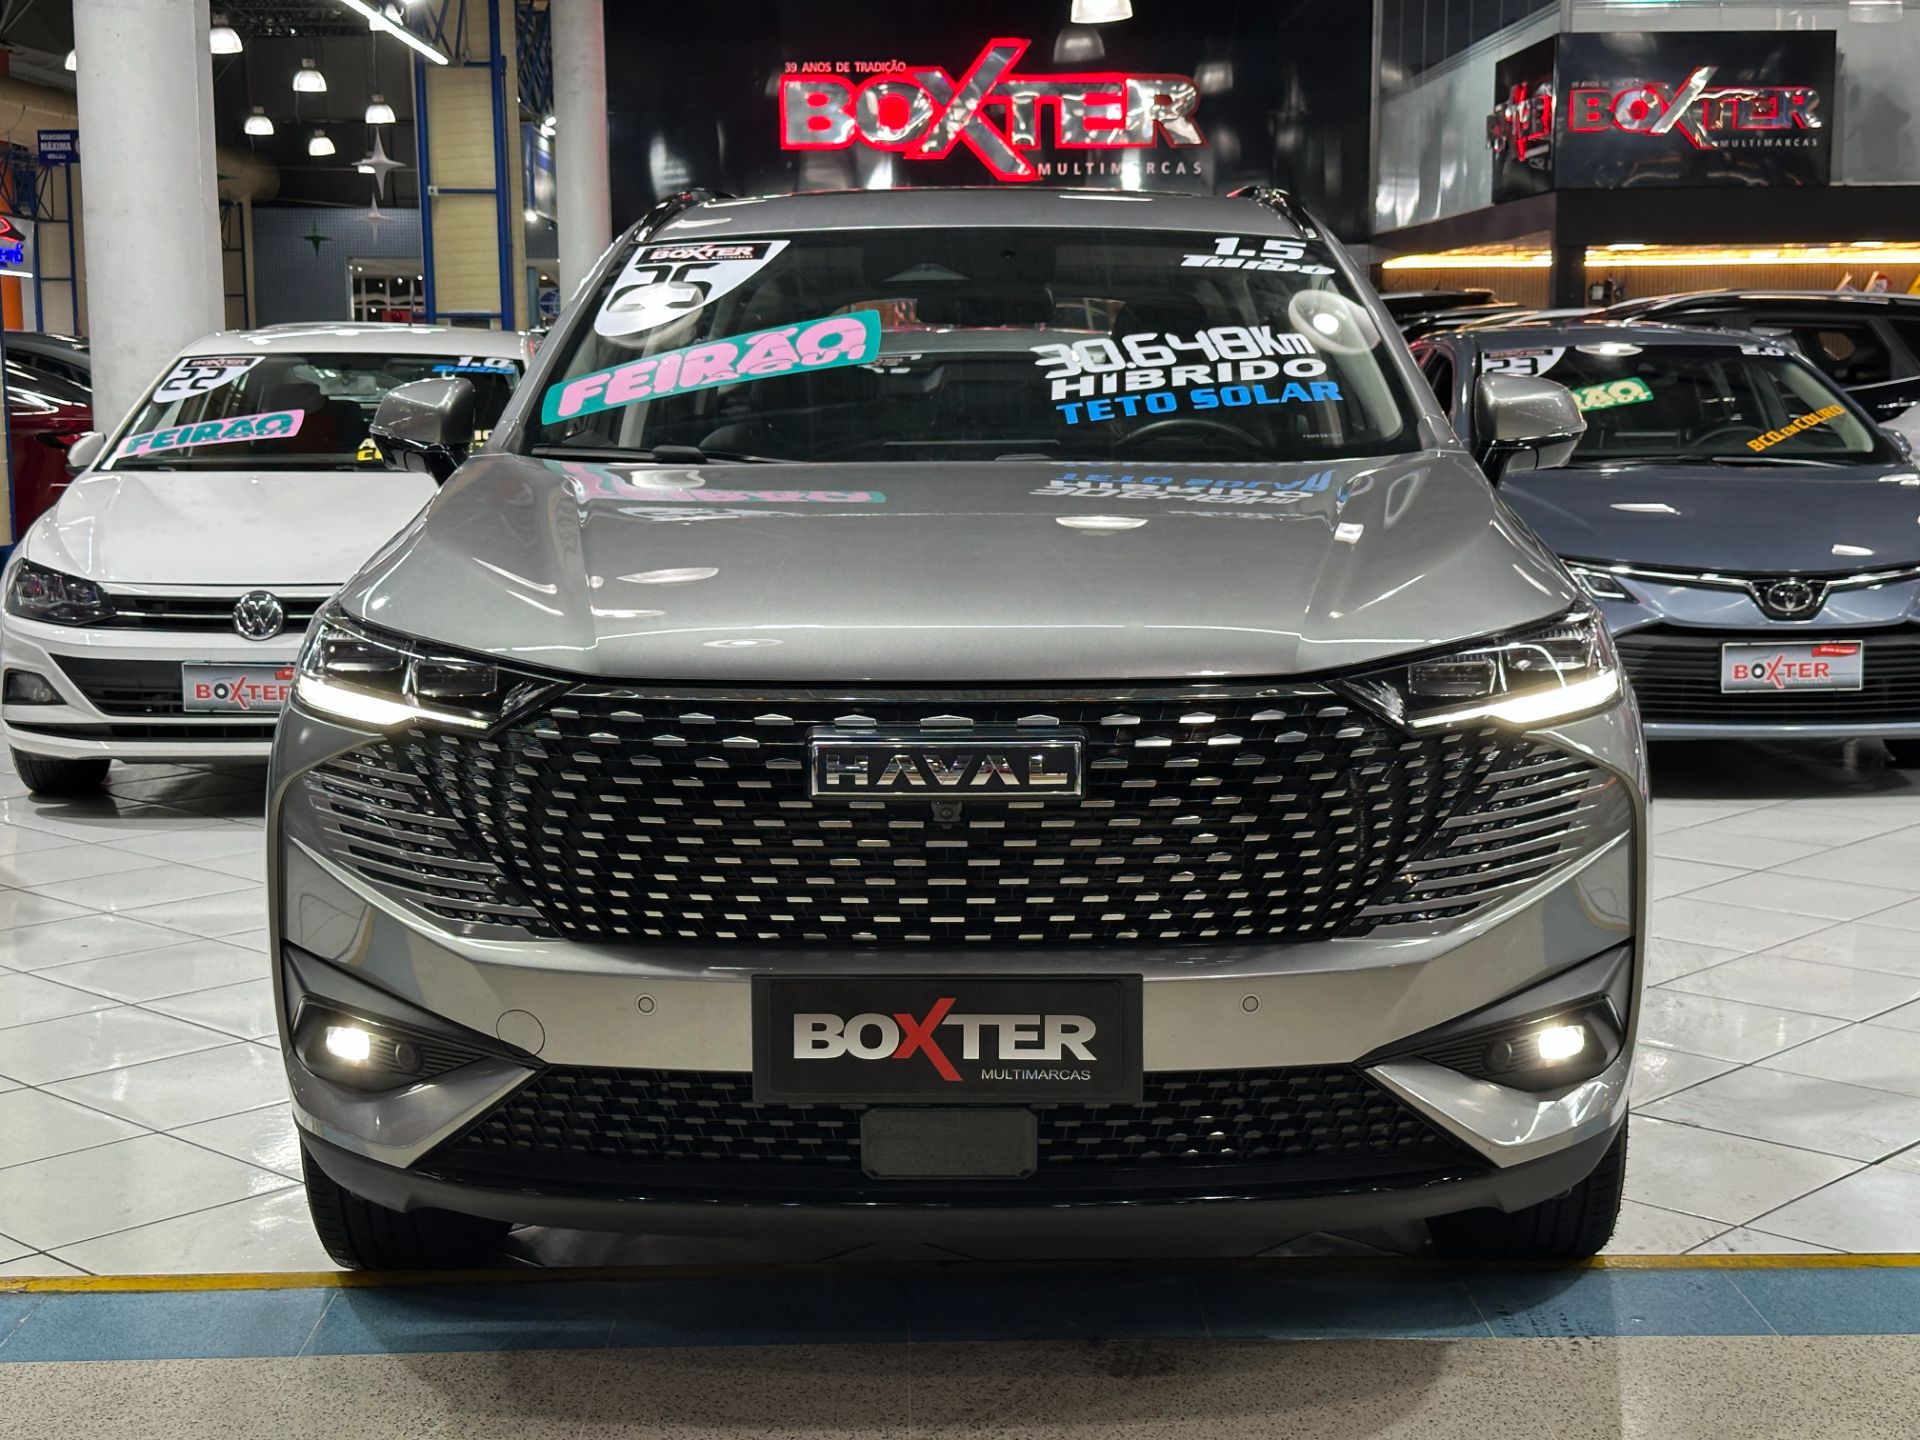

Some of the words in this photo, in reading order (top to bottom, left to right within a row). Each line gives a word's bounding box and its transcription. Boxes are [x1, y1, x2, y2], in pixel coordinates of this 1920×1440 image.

[784, 61, 798, 73] 39
[802, 61, 832, 73] ANOS
[836, 61, 850, 73] DE
[854, 60, 906, 74] TRADIÇÃO
[780, 38, 1209, 181] BOXTER
[1568, 65, 1822, 150] BOXTER
[1719, 137, 1819, 148] MULTIMARCAS
[1037, 162, 1202, 175] MULTIMRCAS
[649, 243, 754, 262] BOXTER
[1215, 237, 1307, 260] 1.5
[1181, 254, 1336, 275] Turbo
[458, 356, 509, 369] 1.0
[1030, 325, 1316, 379] 30.648Km
[161, 367, 227, 392] 22
[558, 318, 867, 417] FEIRÃO
[1056, 391, 1178, 425] TETO
[1190, 381, 1344, 410] SOLAR
[126, 413, 294, 454] FEIRÃO
[1733, 655, 1830, 688] BOXTER
[826, 754, 1068, 785] HAVAL
[793, 998, 1098, 1081] BOXTER
[981, 1068, 1091, 1081] MULTIMARCAS
